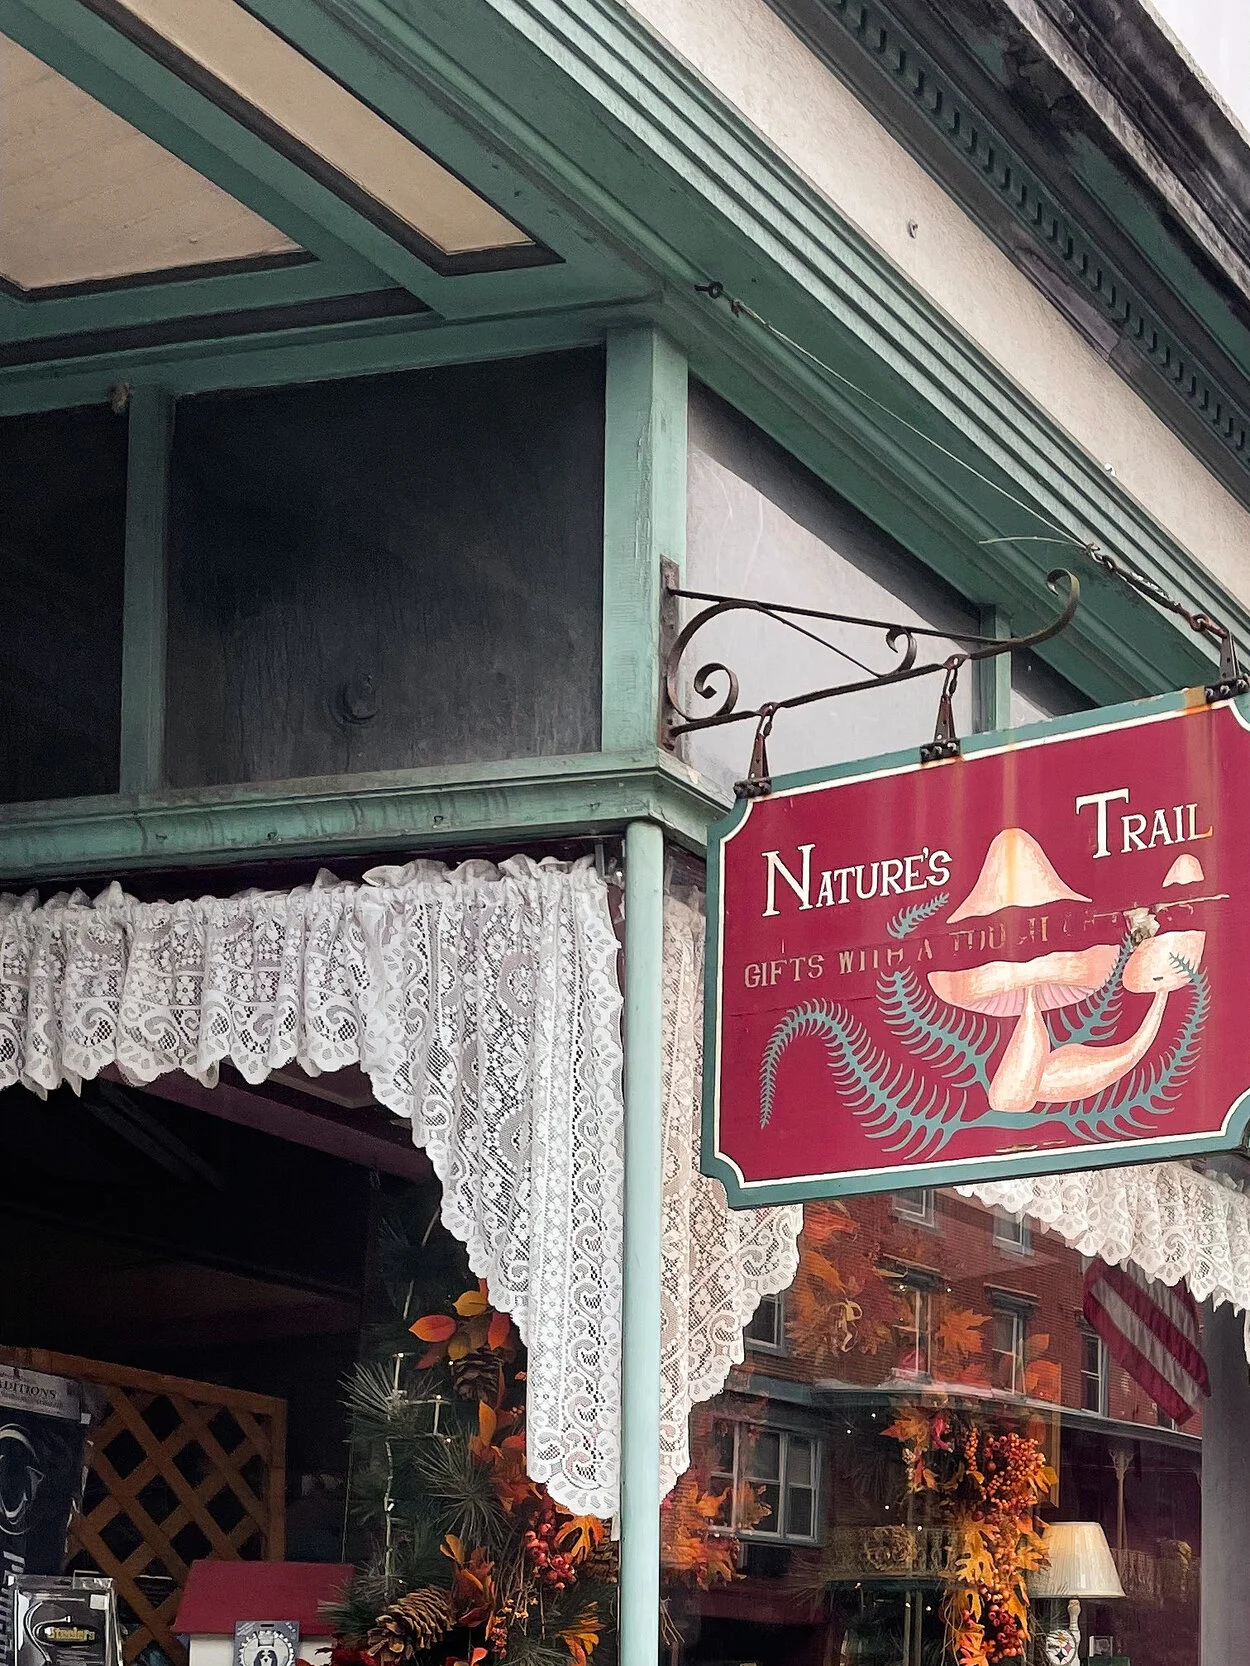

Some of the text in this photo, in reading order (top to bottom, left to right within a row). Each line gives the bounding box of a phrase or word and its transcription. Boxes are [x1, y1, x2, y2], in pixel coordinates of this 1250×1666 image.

[761, 786, 1214, 918] NATURE'S TRAIL
[744, 953, 825, 989] GIFTS
